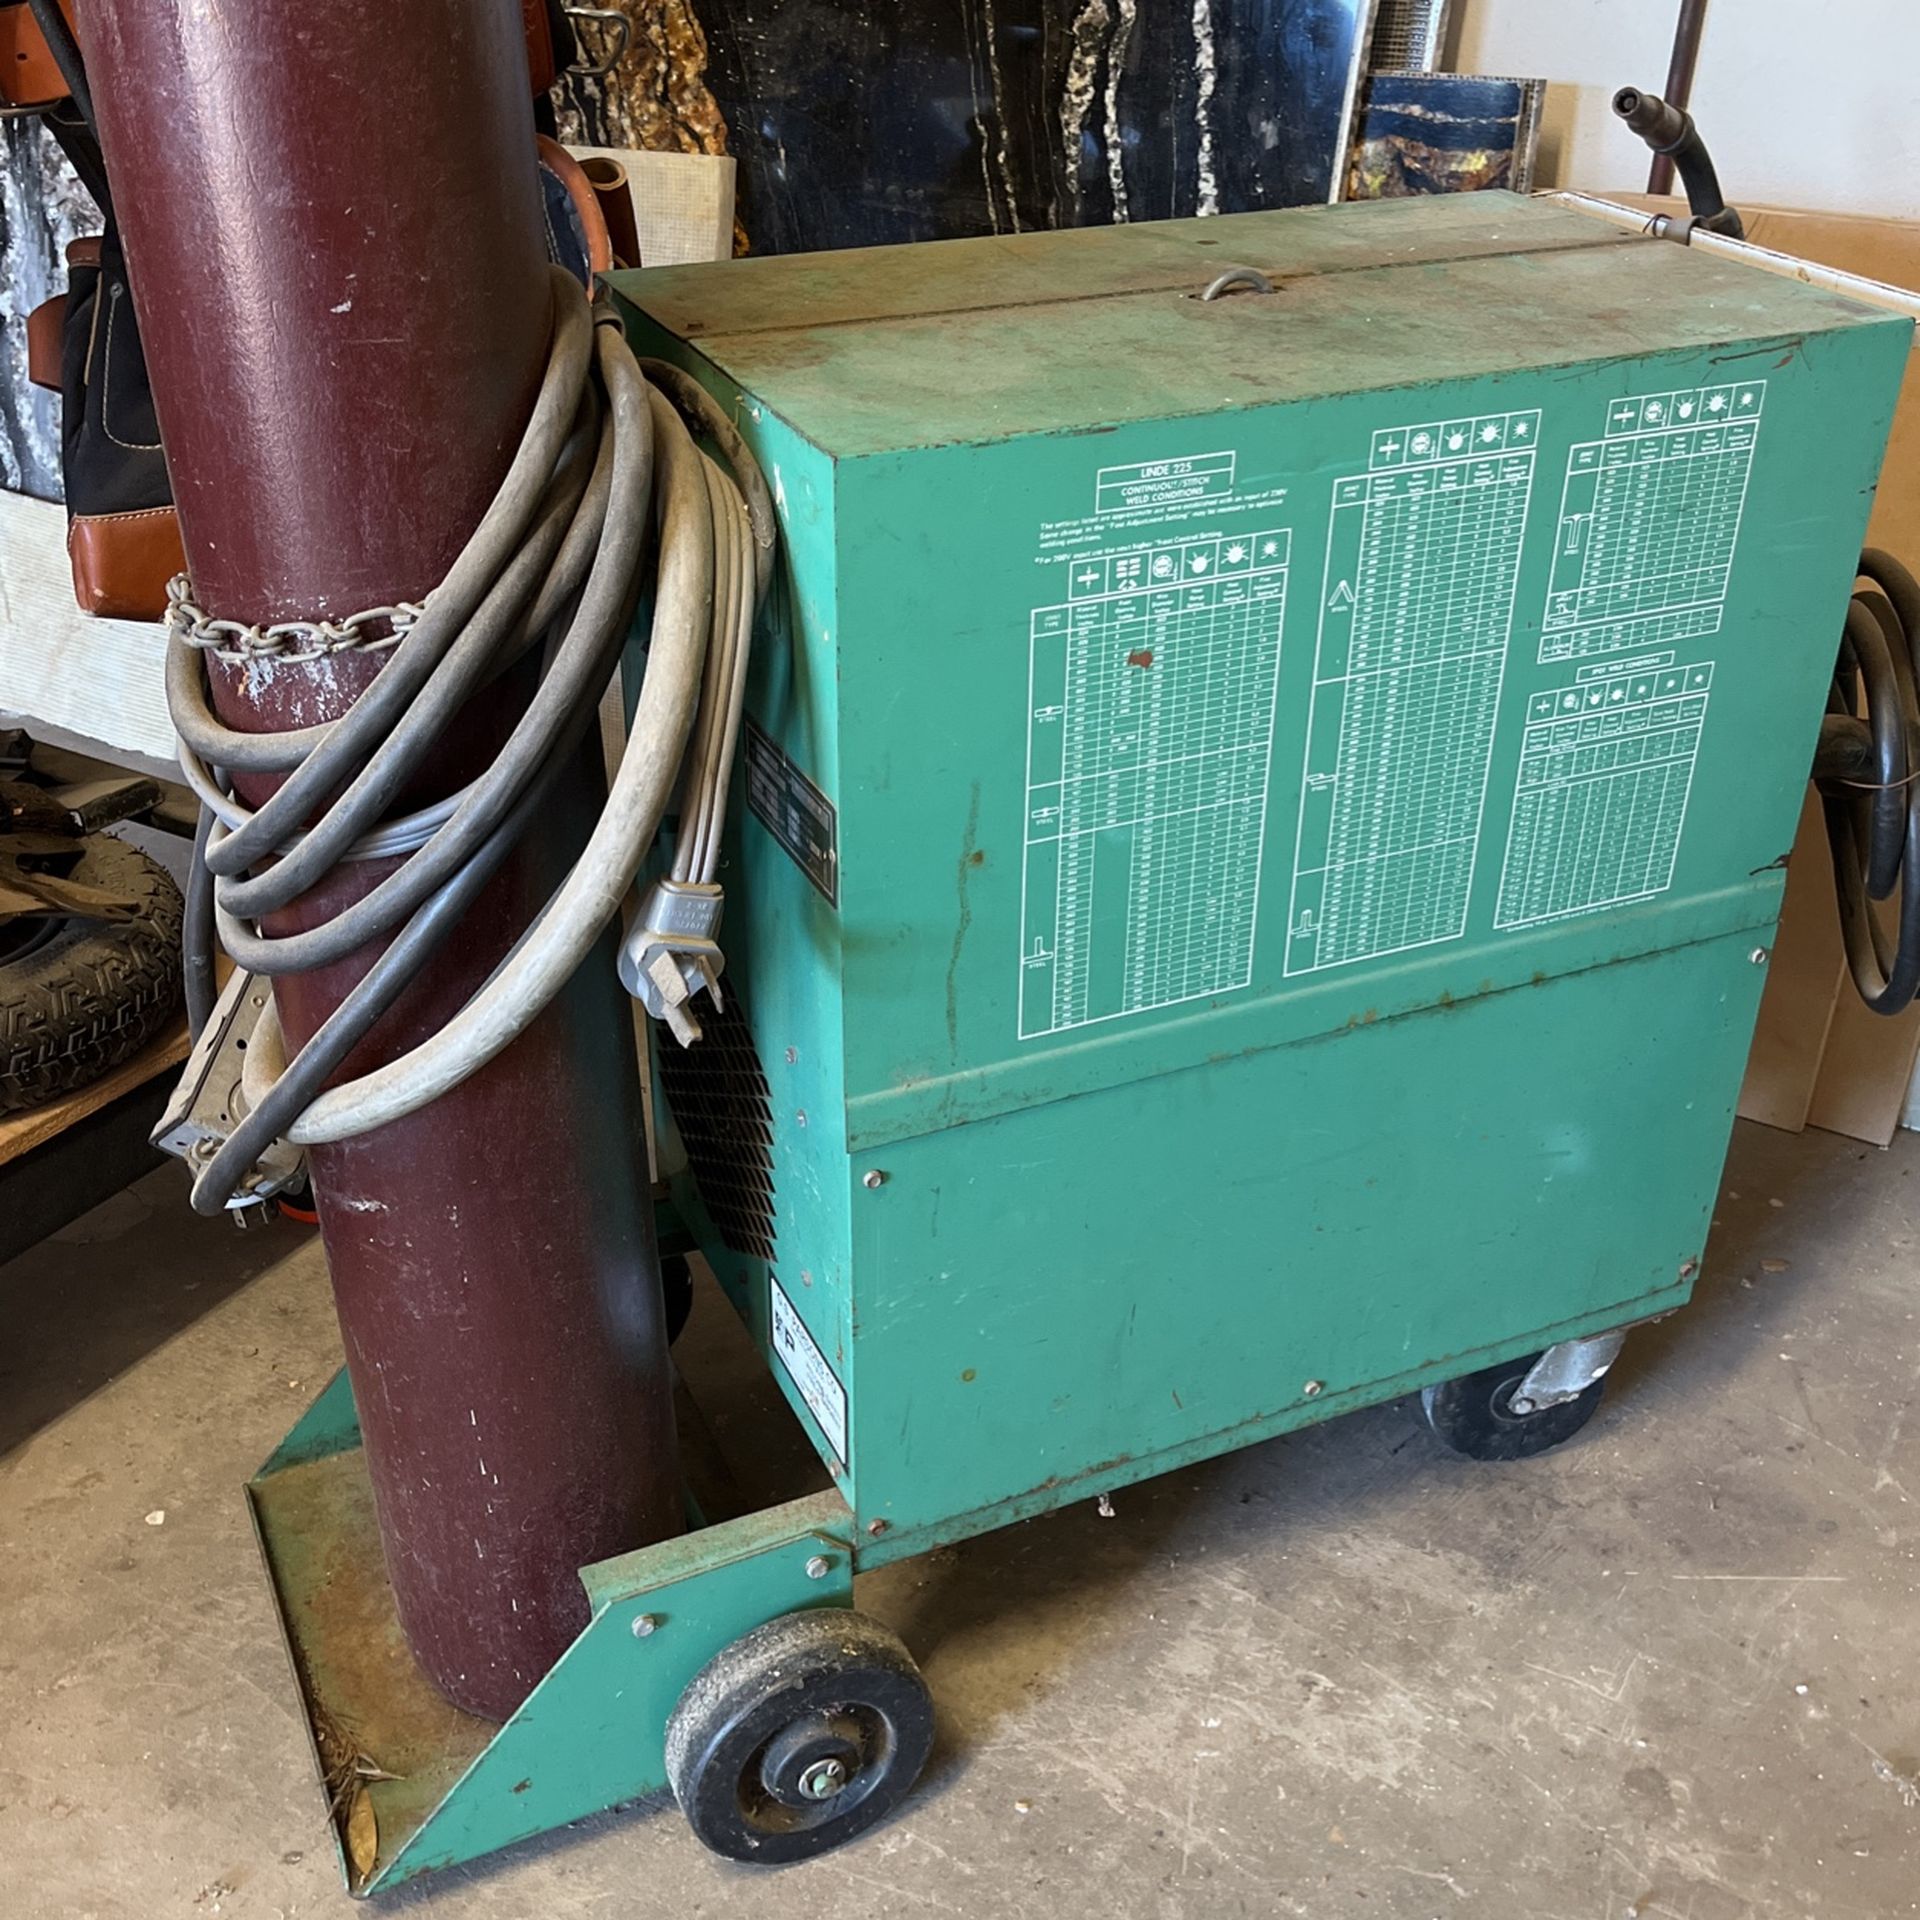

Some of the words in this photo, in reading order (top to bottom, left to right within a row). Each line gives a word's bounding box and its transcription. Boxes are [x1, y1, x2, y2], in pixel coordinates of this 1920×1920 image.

[1141, 464, 1169, 478] LINDE
[1172, 462, 1192, 474] 225
[1126, 494, 1149, 505] WELD
[1152, 486, 1204, 502] CONDITIONS
